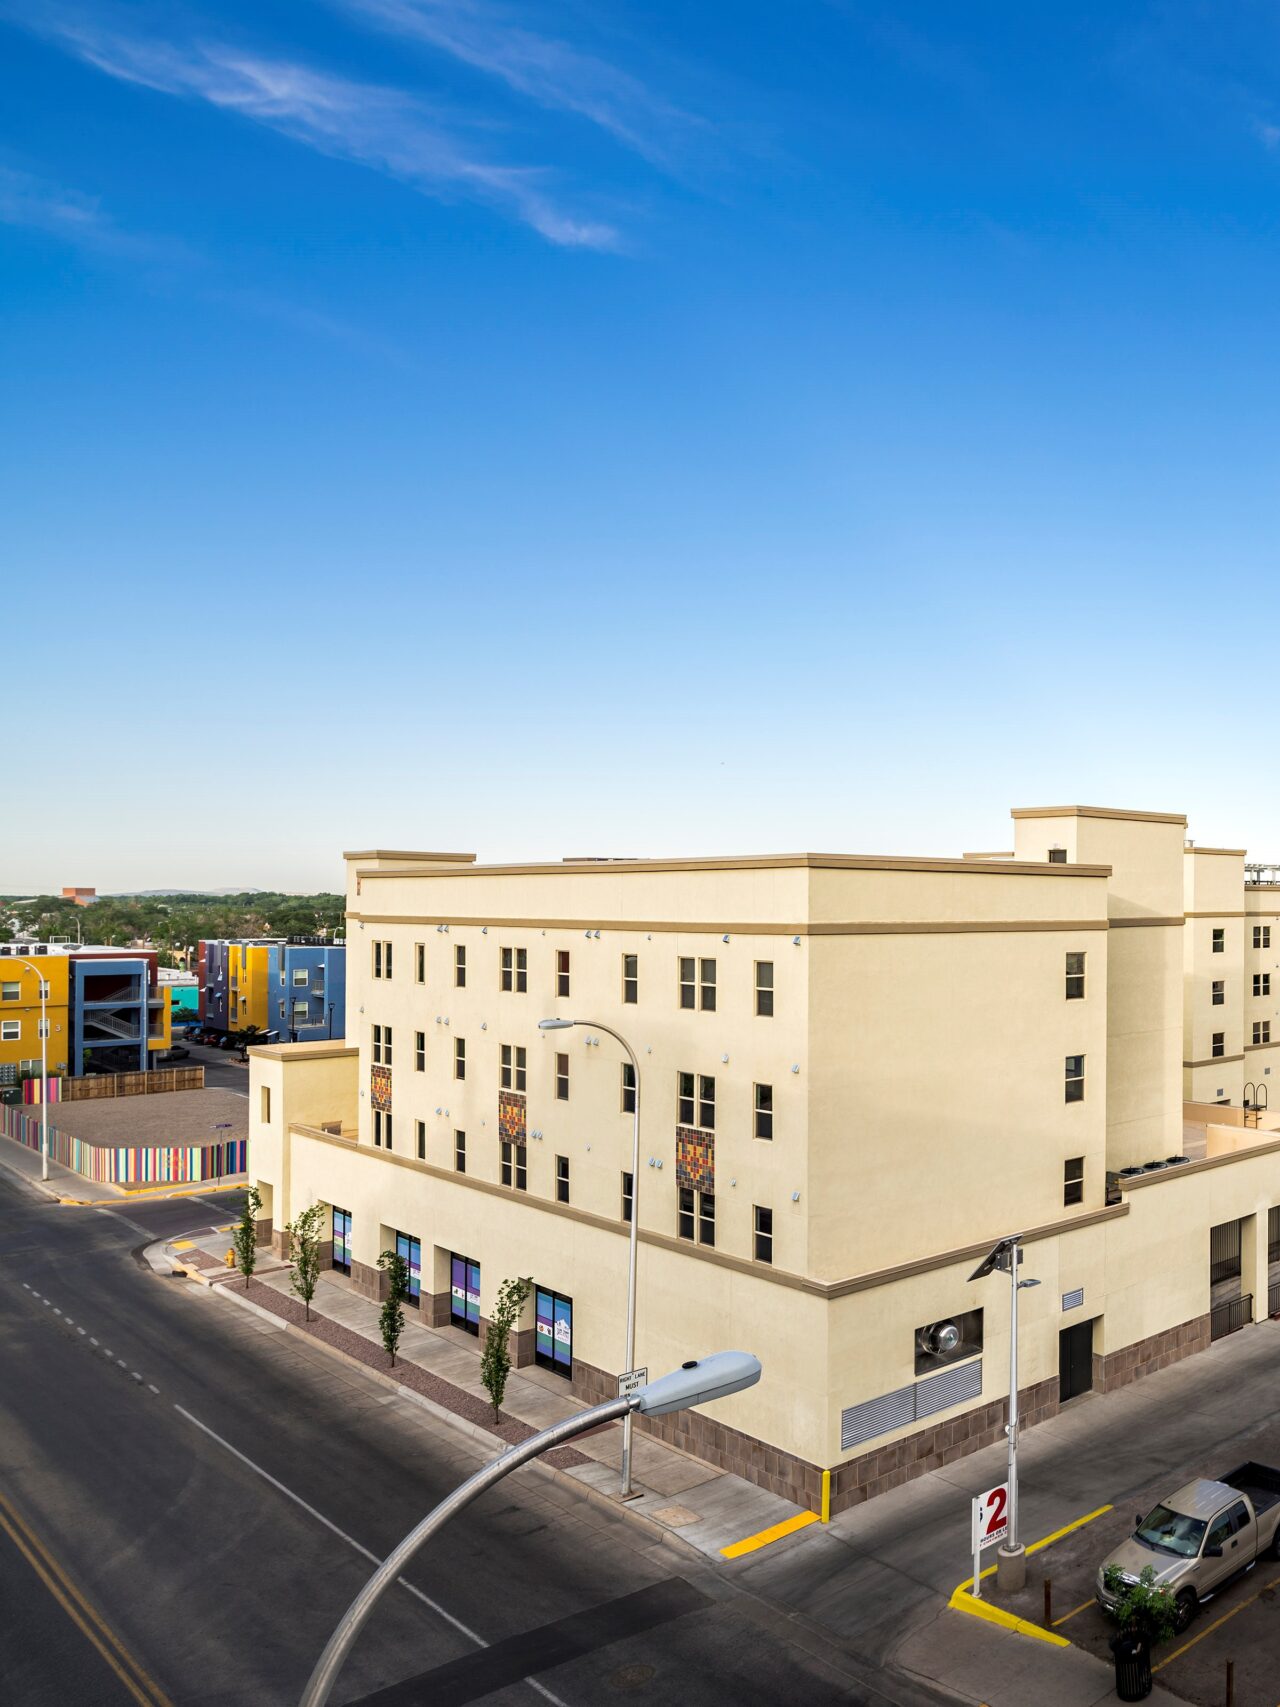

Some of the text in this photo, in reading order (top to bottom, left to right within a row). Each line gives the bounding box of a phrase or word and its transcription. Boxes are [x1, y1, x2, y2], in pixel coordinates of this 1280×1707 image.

[634, 1371, 645, 1379] LANE
[625, 1381, 639, 1390] MUST
[986, 1487, 1007, 1535] 2
[980, 1532, 995, 1543] HOURS
